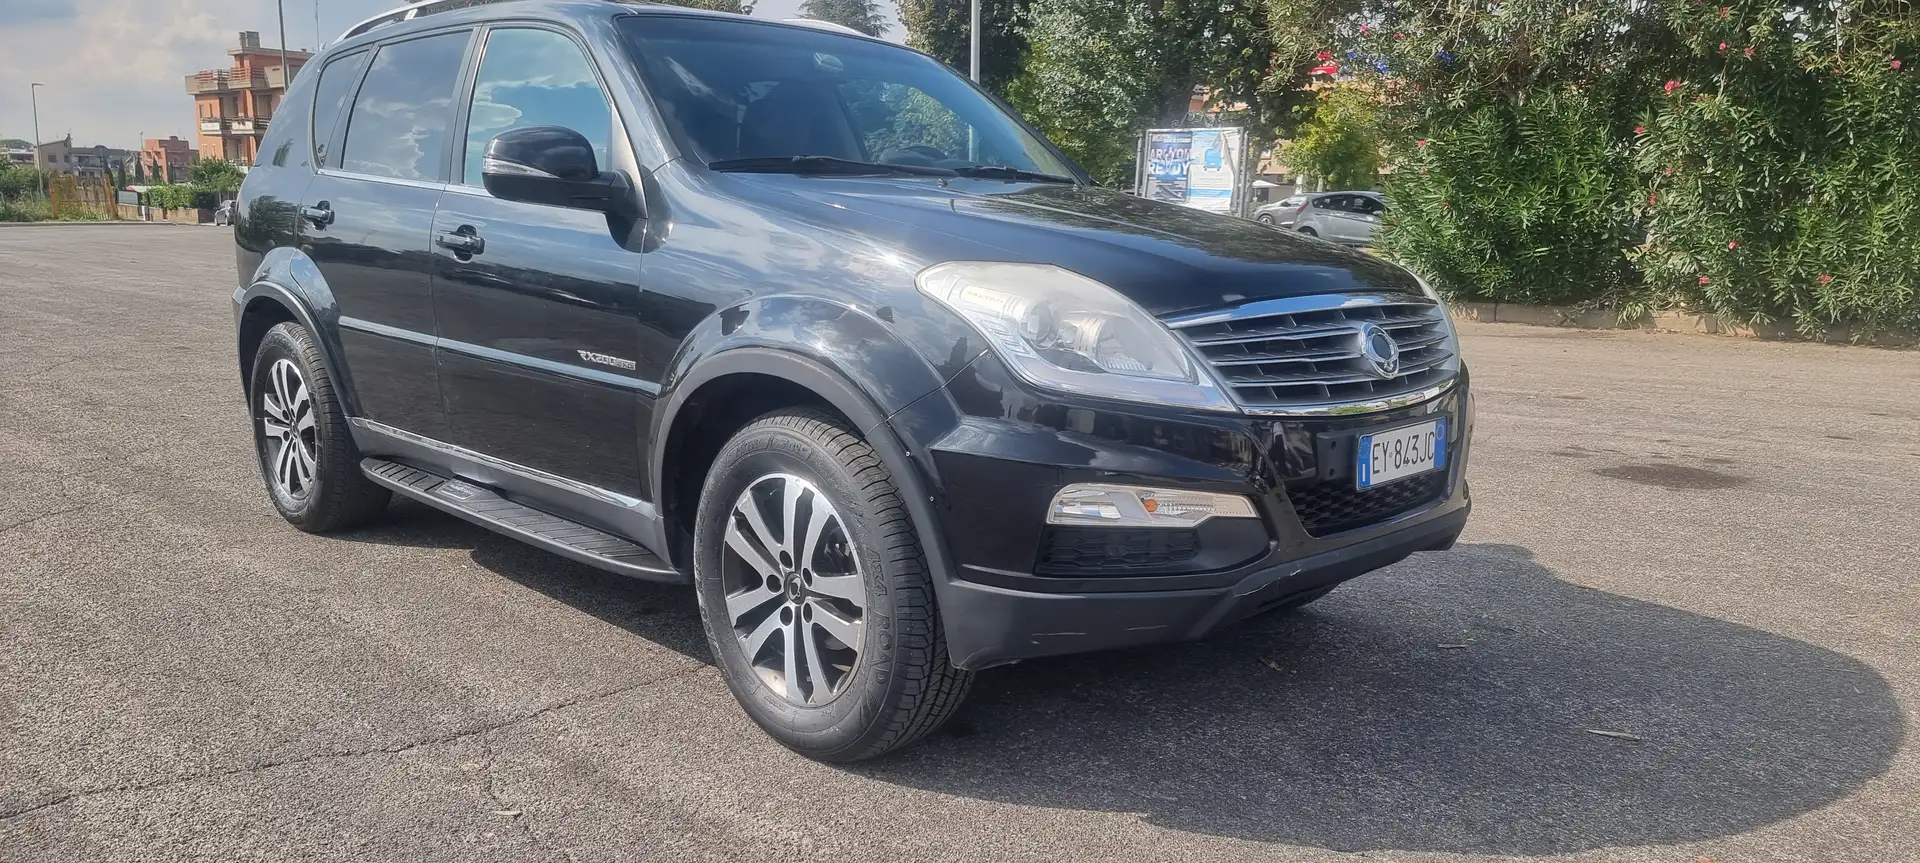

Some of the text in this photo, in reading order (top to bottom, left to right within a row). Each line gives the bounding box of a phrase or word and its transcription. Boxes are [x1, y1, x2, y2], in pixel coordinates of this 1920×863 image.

[1148, 161, 1190, 175] REDY
[1372, 431, 1435, 475] EY 843JC
[869, 610, 894, 685] ROAD
